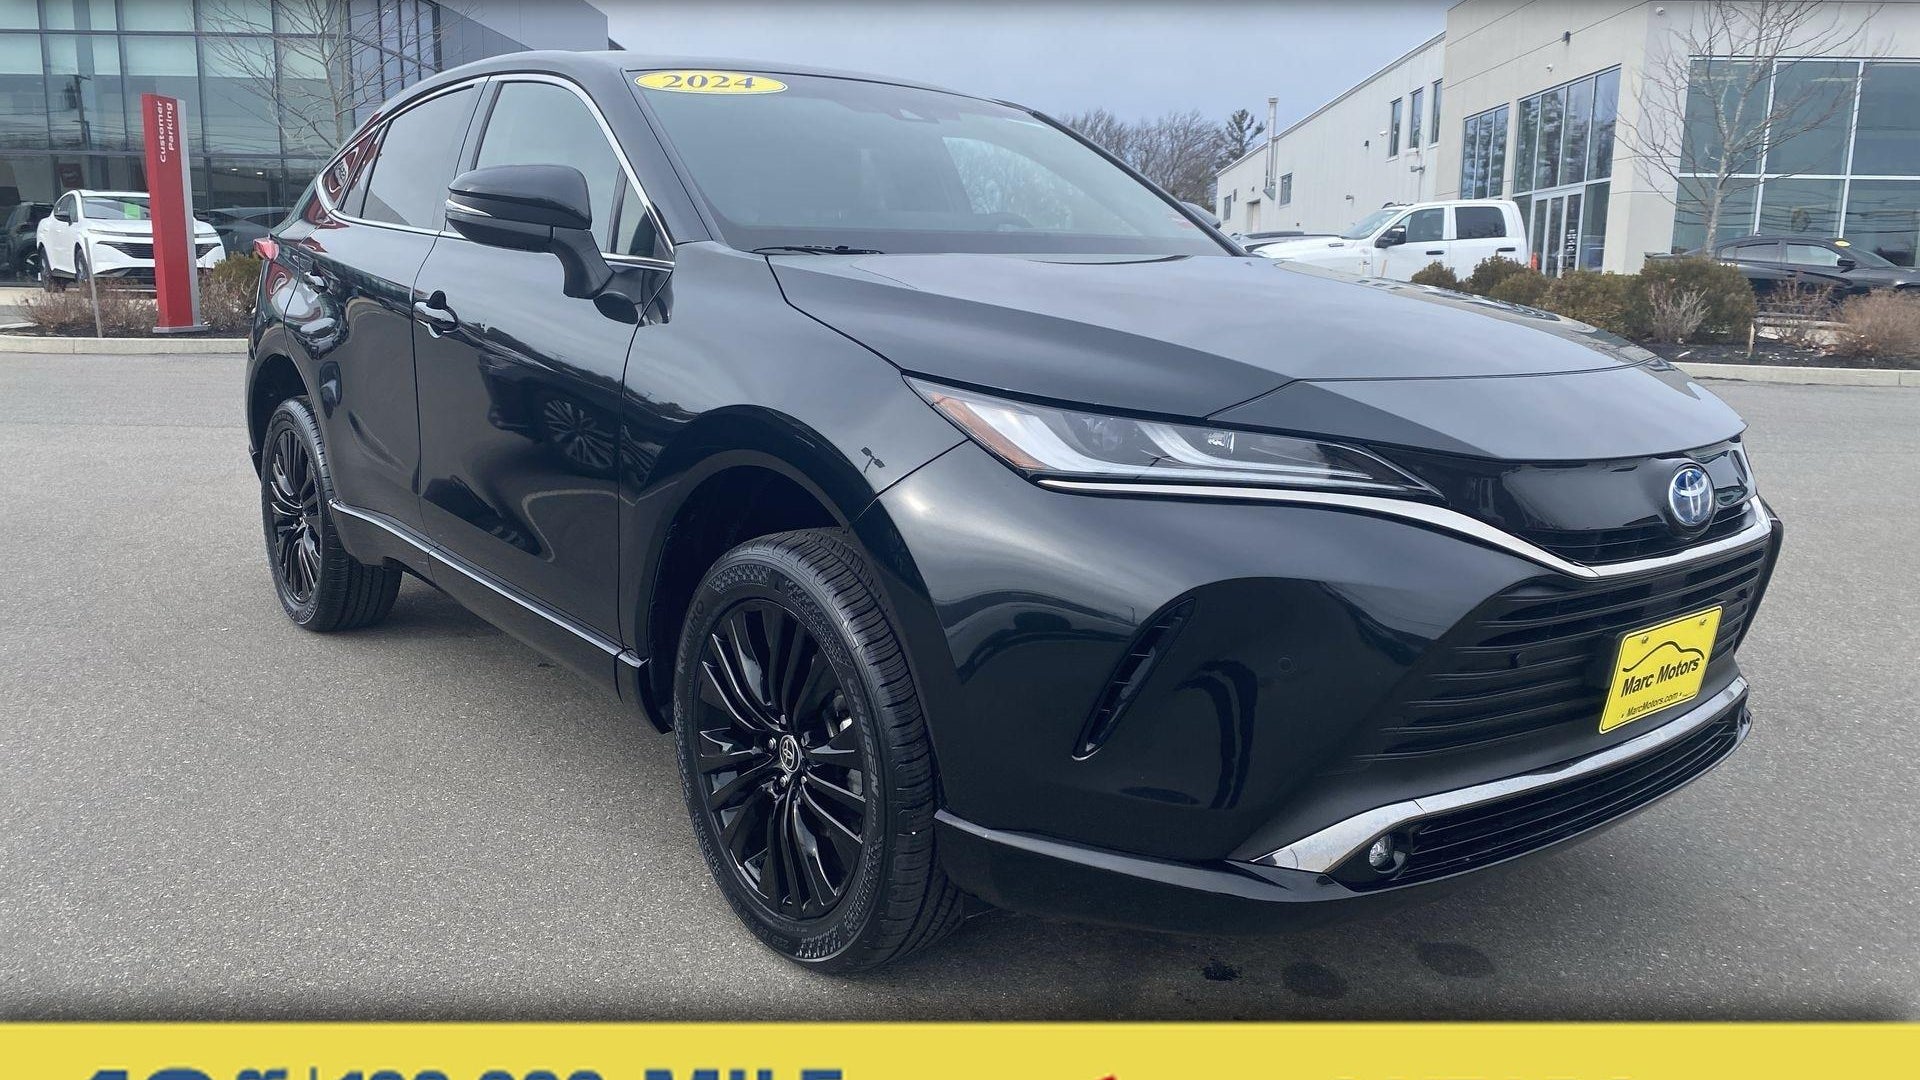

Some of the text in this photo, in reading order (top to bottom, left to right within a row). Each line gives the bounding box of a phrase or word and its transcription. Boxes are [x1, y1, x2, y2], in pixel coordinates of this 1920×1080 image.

[662, 74, 756, 89] 2024
[156, 100, 167, 163] Customer
[1620, 657, 1700, 698] Marc Motors
[1626, 692, 1679, 717] MarcMotors.com
